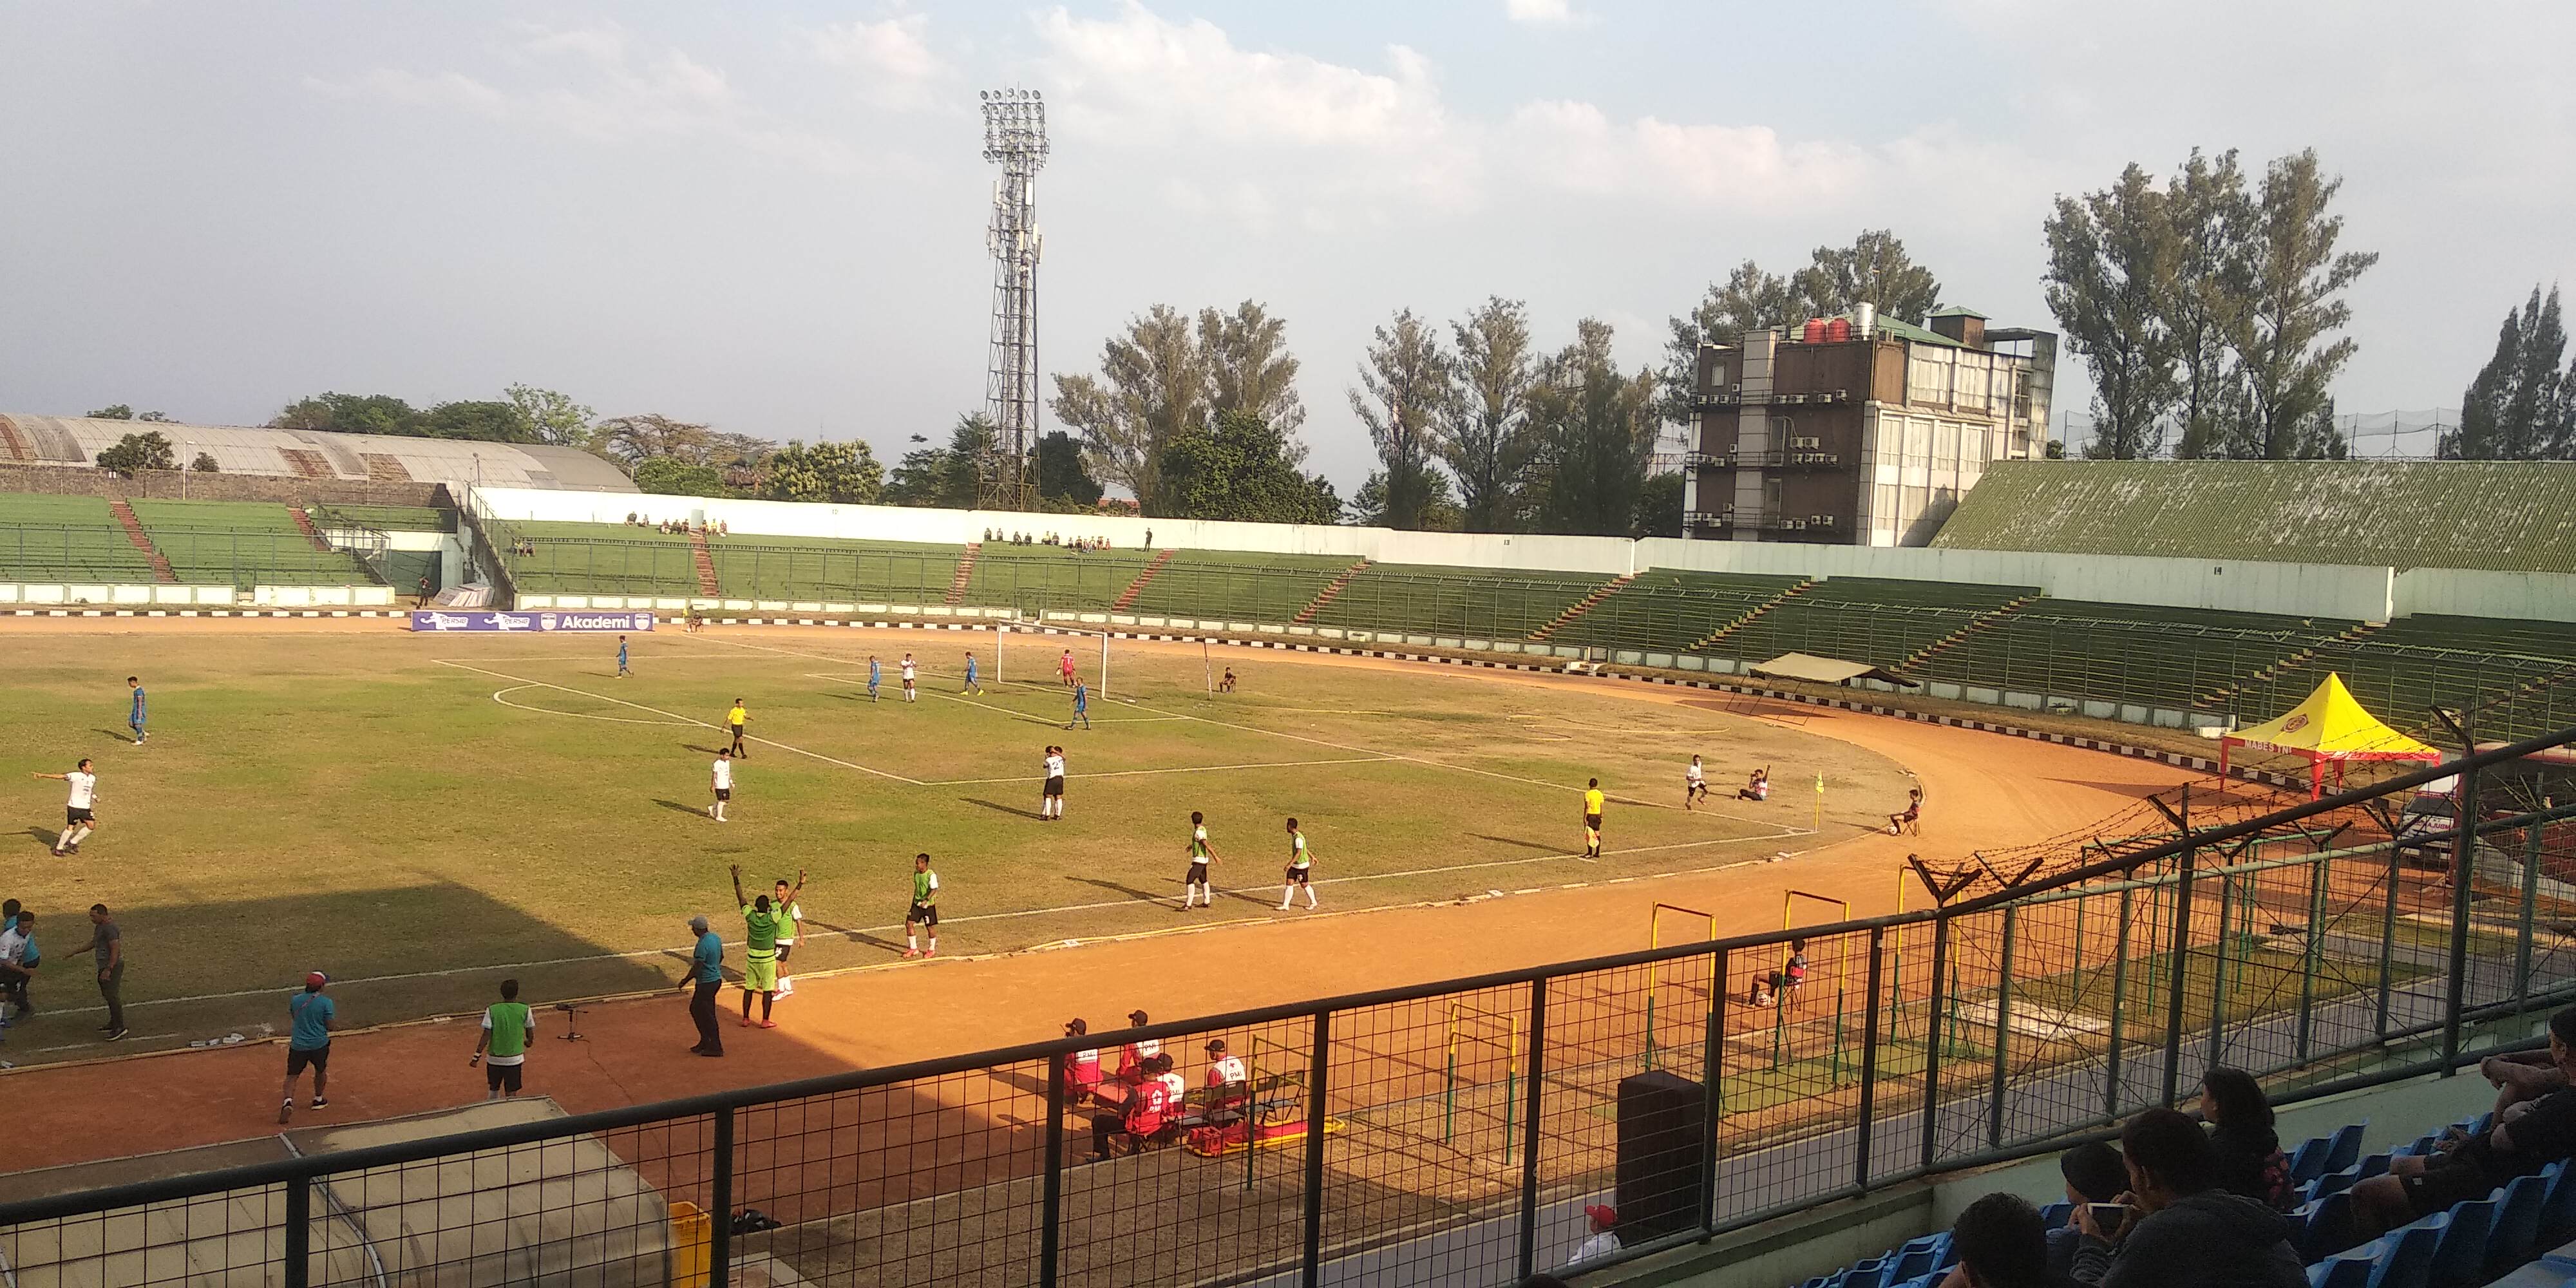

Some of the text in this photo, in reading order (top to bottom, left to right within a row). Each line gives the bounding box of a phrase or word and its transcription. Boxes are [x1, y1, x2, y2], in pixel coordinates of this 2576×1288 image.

[2214, 567, 2222, 575] 14
[562, 615, 630, 629] Akademi
[2244, 739, 2292, 754] MABES TNI
[1230, 1071, 1242, 1079] PMI
